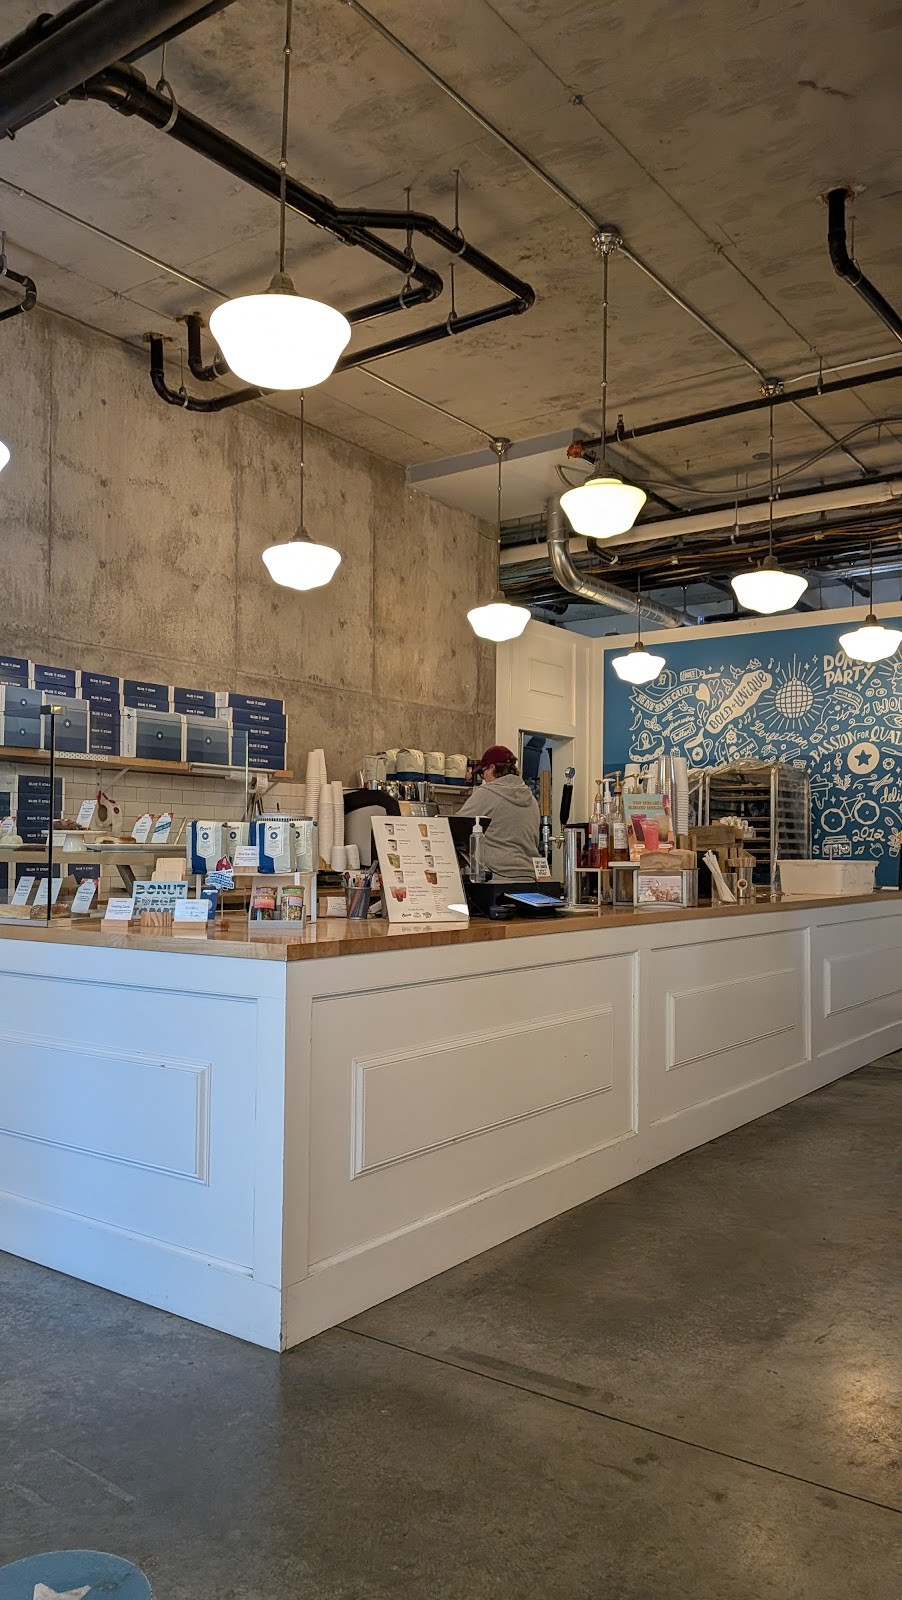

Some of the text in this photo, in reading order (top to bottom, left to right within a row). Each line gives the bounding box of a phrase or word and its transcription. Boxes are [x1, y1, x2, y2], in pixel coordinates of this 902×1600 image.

[823, 650, 872, 671] DON
[823, 666, 876, 688] PARTY
[655, 697, 672, 713] SAIS
[670, 685, 694, 701] QUOI
[708, 704, 734, 730] BOLD
[735, 671, 767, 707] UNIQUE
[873, 697, 902, 716] WO
[809, 725, 902, 762] PASSION FOR QUAL
[880, 786, 902, 803] deli
[852, 827, 886, 842] 2012
[136, 884, 185, 895] DONUT
[134, 896, 184, 906] FORGE
